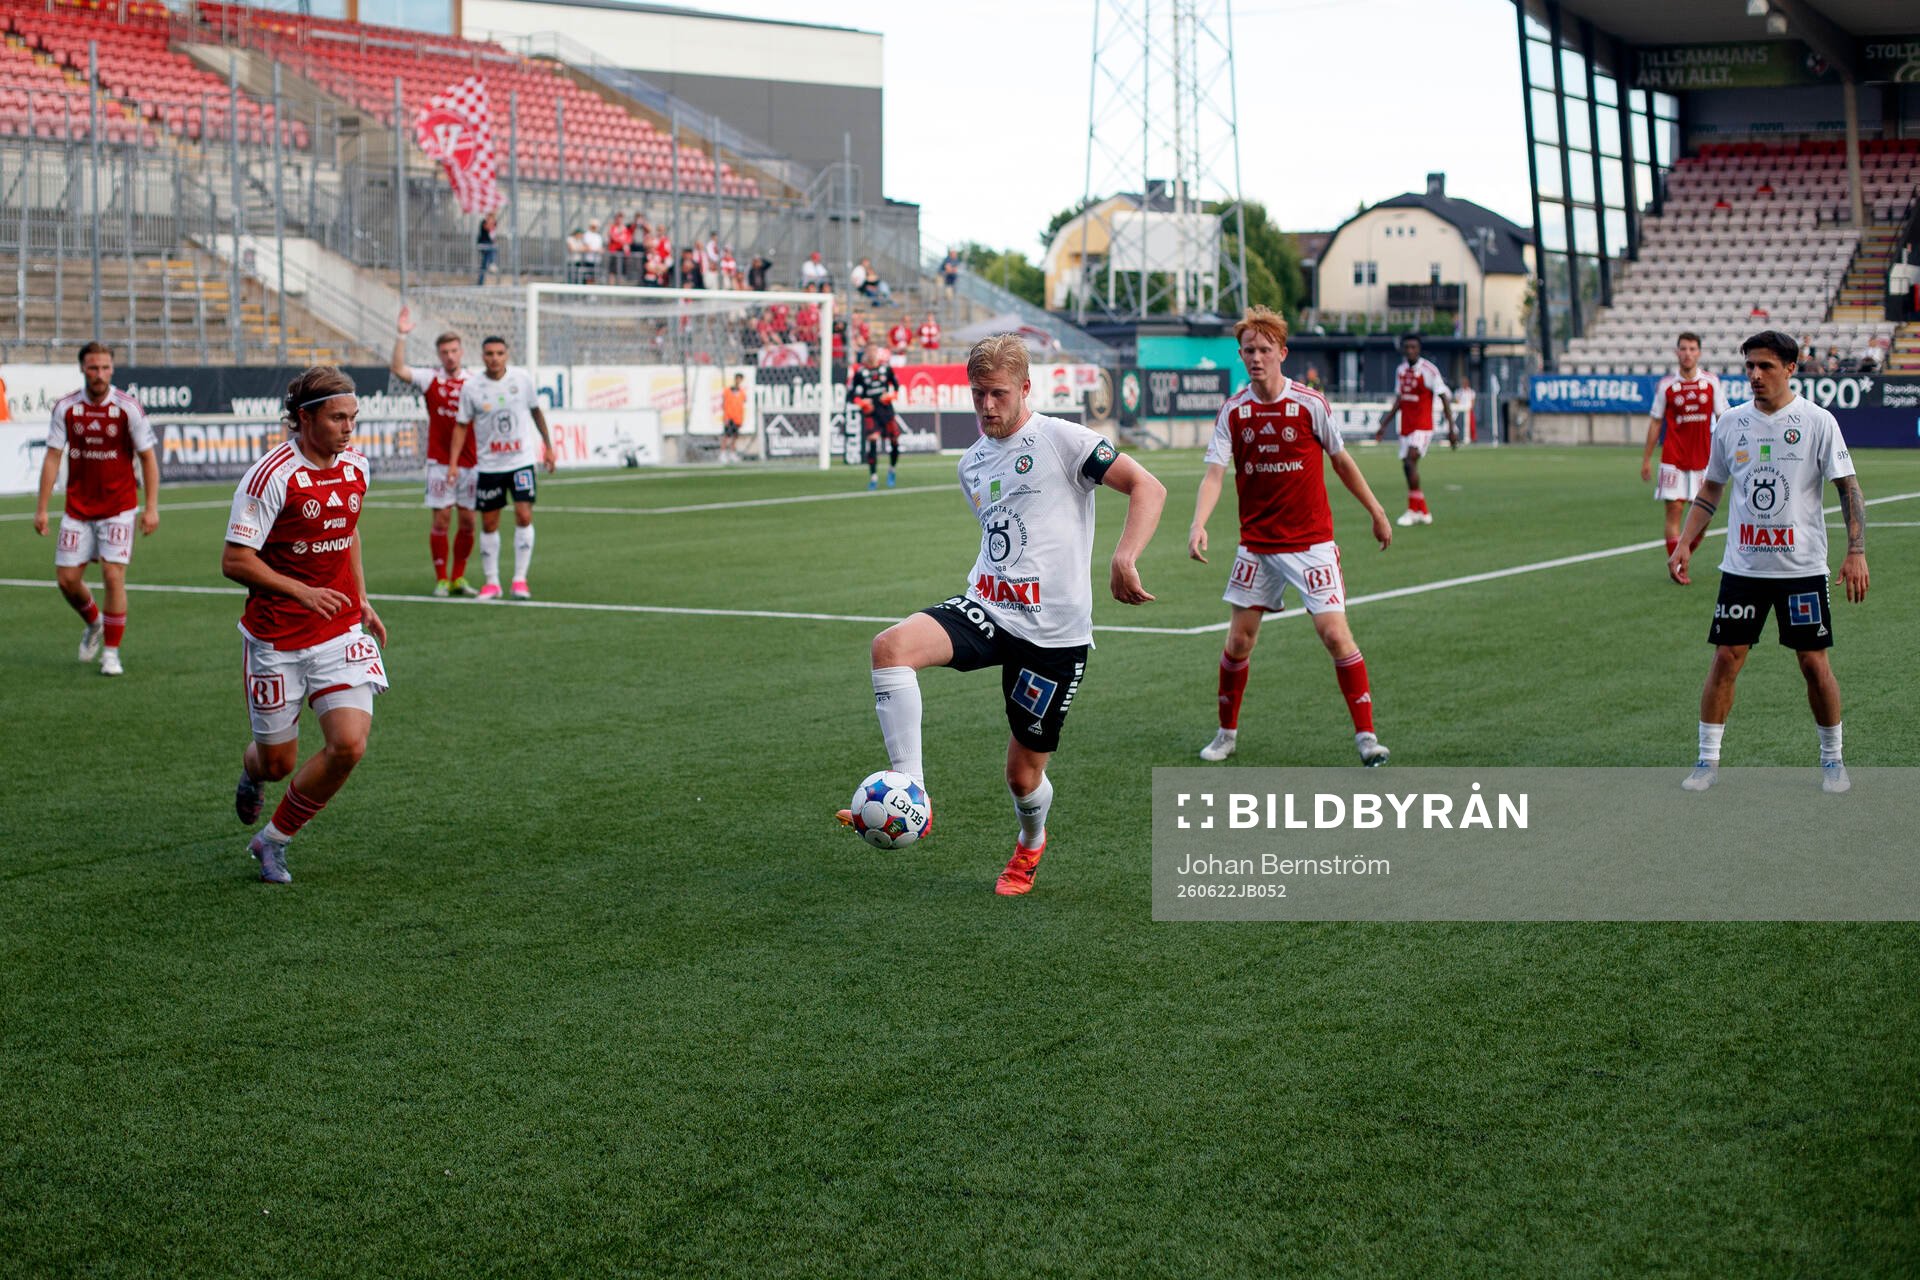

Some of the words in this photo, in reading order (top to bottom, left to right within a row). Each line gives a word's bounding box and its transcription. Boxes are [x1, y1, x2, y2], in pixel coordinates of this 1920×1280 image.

[1639, 47, 1769, 67] TILLSAMMANS
[1637, 67, 1661, 86] ÄR
[1665, 67, 1685, 85] VI
[1688, 67, 1733, 85] ALLT.
[1536, 381, 1581, 401] PUTS
[1256, 460, 1304, 473] SANDVIK
[1012, 513, 1028, 547] PASSION
[1740, 523, 1795, 546] MAXI
[976, 573, 1041, 605] MAXI
[890, 796, 924, 826] SELECT
